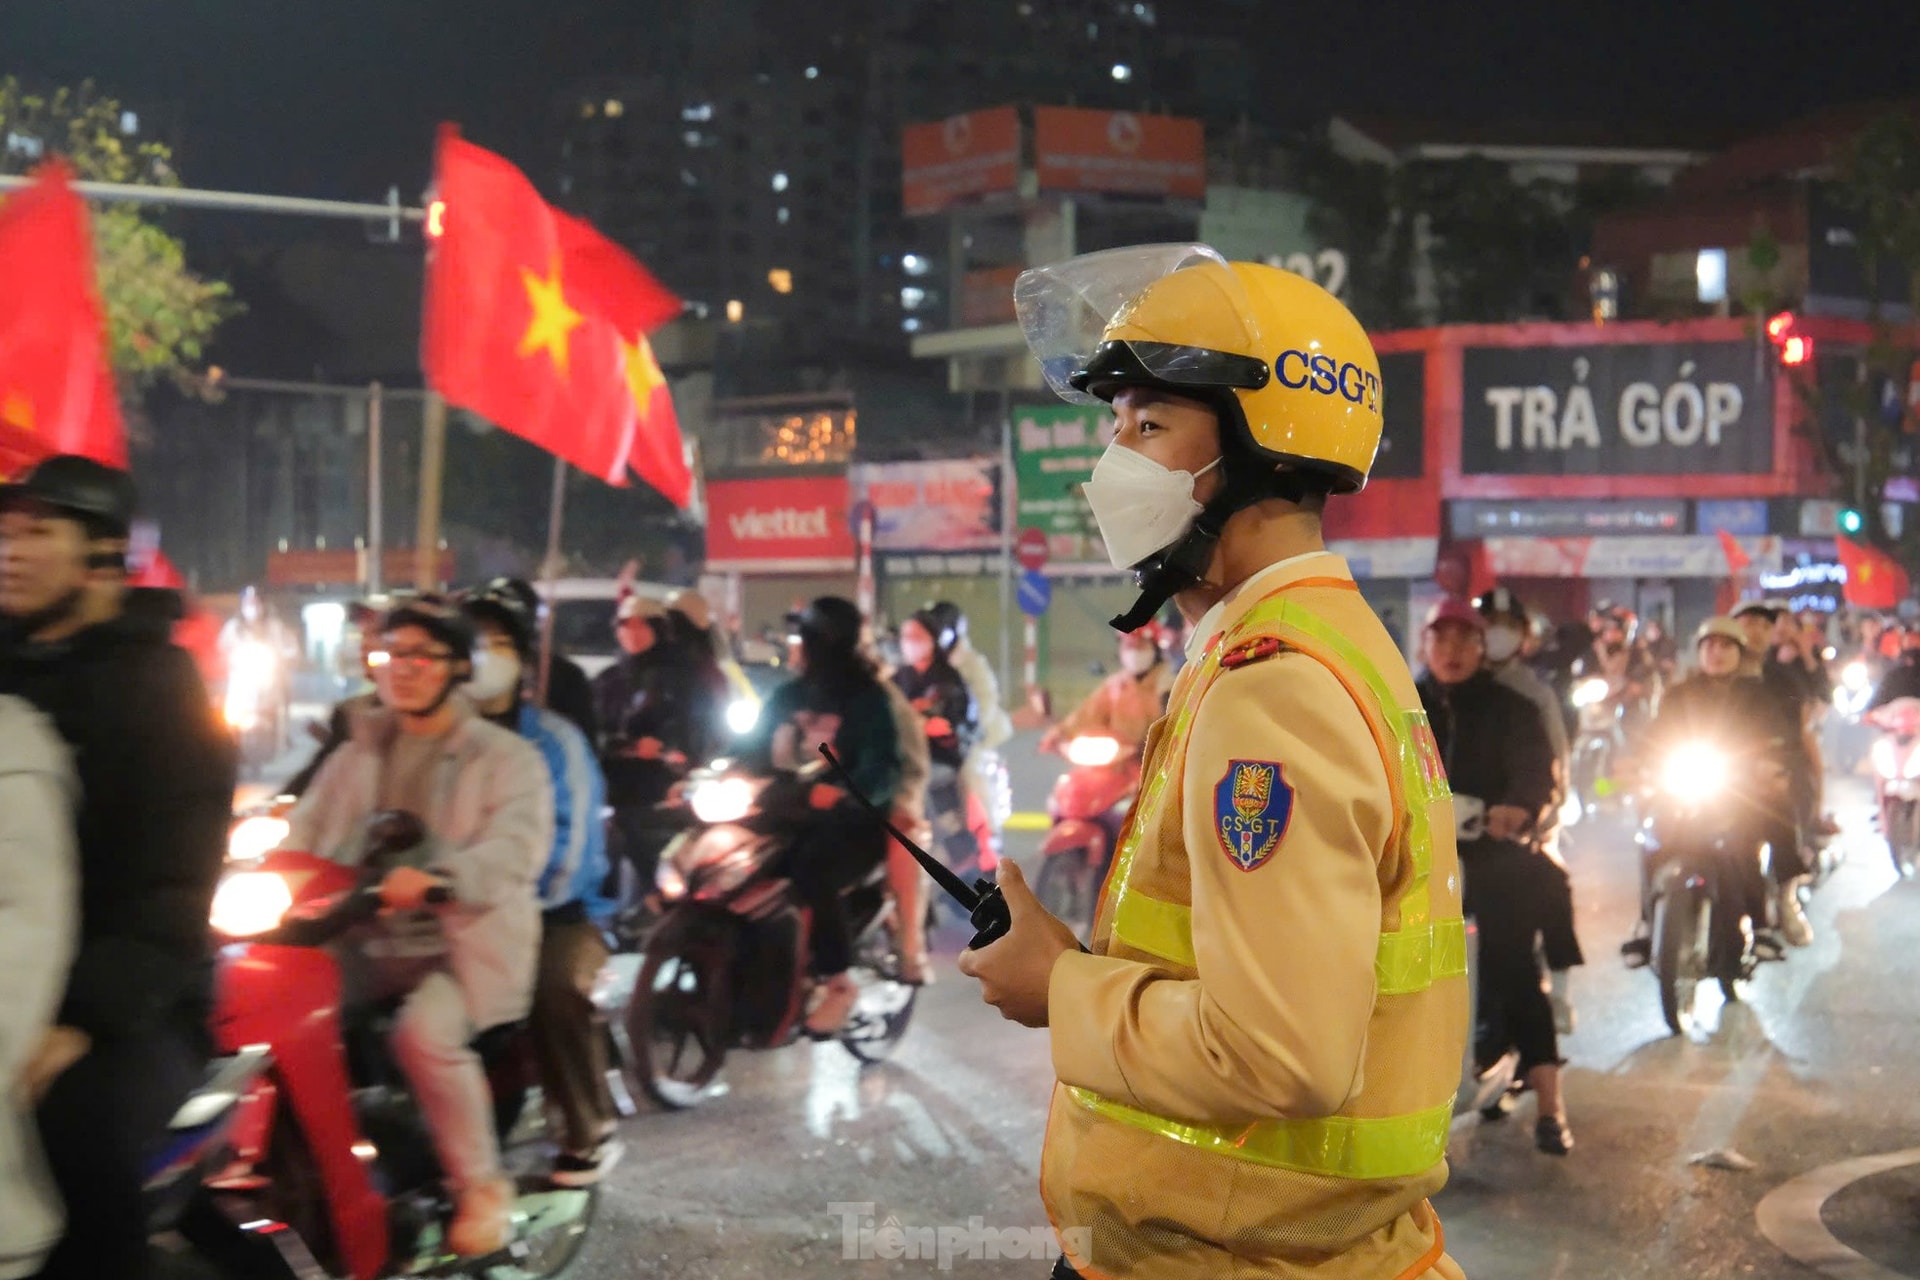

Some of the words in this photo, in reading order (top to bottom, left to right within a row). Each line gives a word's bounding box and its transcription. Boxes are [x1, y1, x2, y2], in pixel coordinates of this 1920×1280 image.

[1275, 349, 1379, 413] CSGT
[1485, 356, 1601, 450] TRẢ
[1617, 360, 1743, 448] GÓP
[728, 506, 829, 541] viettel
[1222, 815, 1279, 834] CSGT
